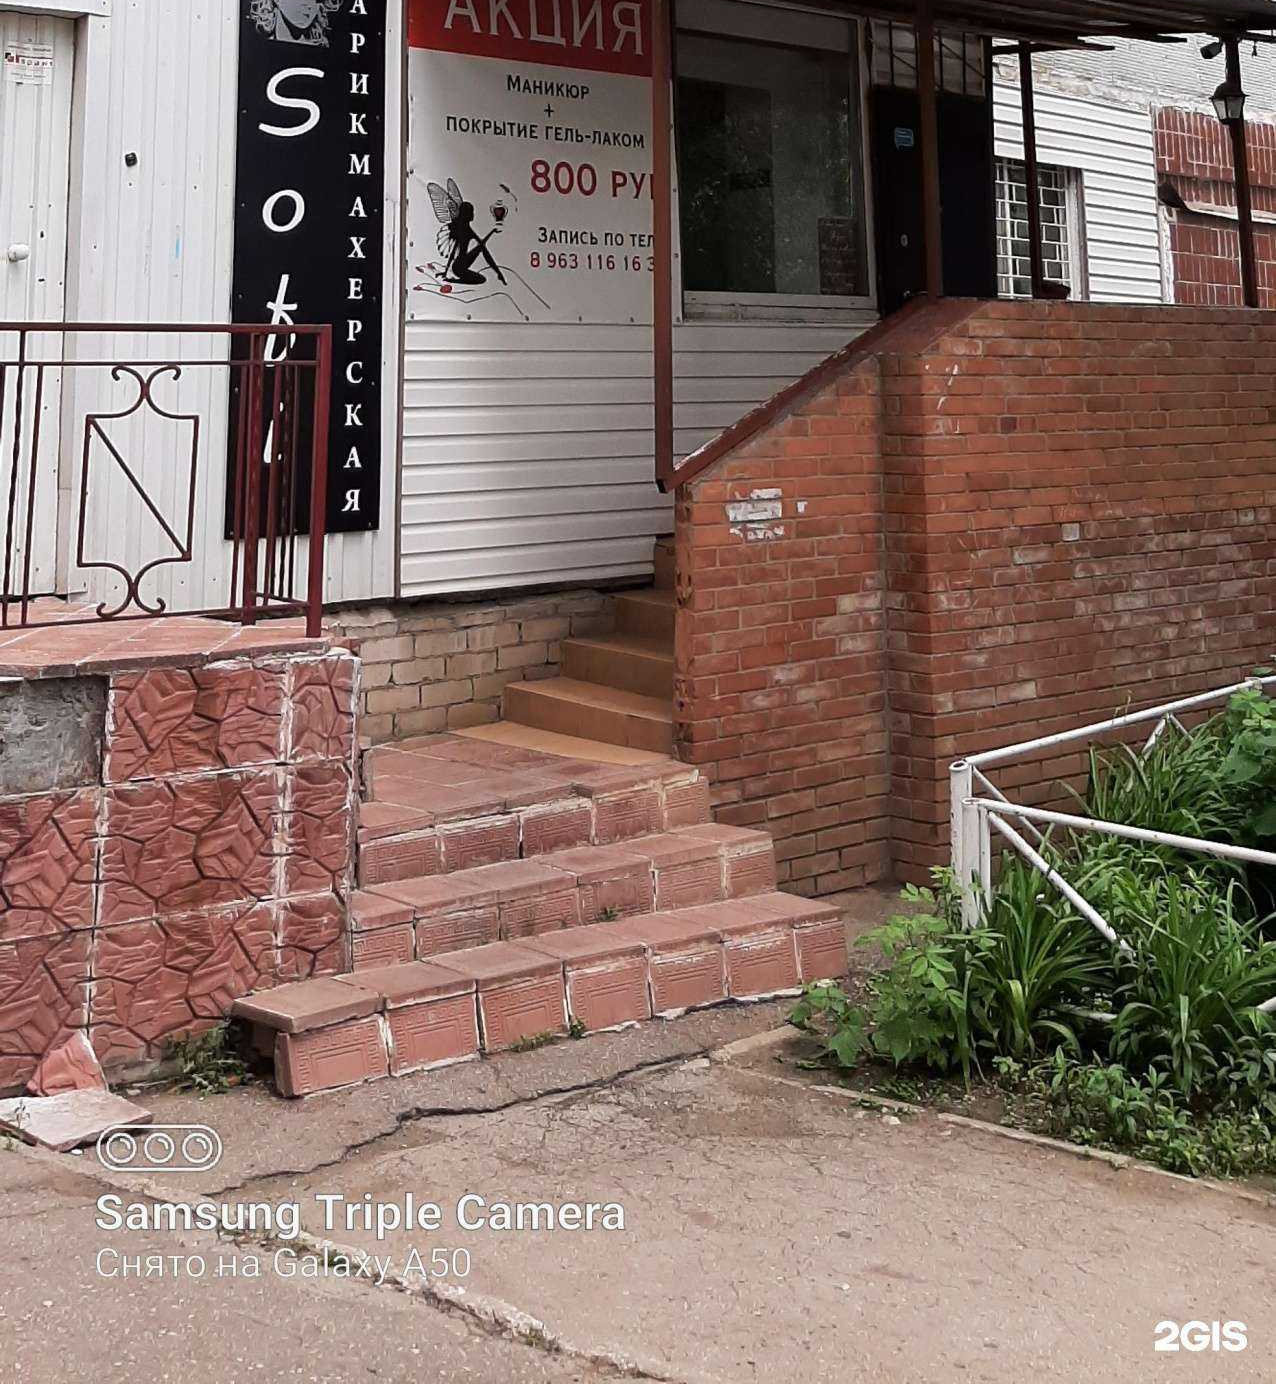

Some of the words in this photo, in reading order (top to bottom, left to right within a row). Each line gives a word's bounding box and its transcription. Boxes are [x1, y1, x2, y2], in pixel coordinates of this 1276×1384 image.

[446, 116, 538, 140] ПОКРЫТИЕ
[545, 126, 645, 149] ГЕЛЬ-ЛАКОМ
[530, 159, 597, 196] 800
[611, 170, 654, 200] РУ
[538, 227, 598, 246] ЗАПИСЬ
[604, 232, 624, 247] ПО
[530, 251, 540, 268] 8
[547, 252, 578, 269] 963
[587, 254, 615, 271] 116
[624, 255, 641, 271] 16
